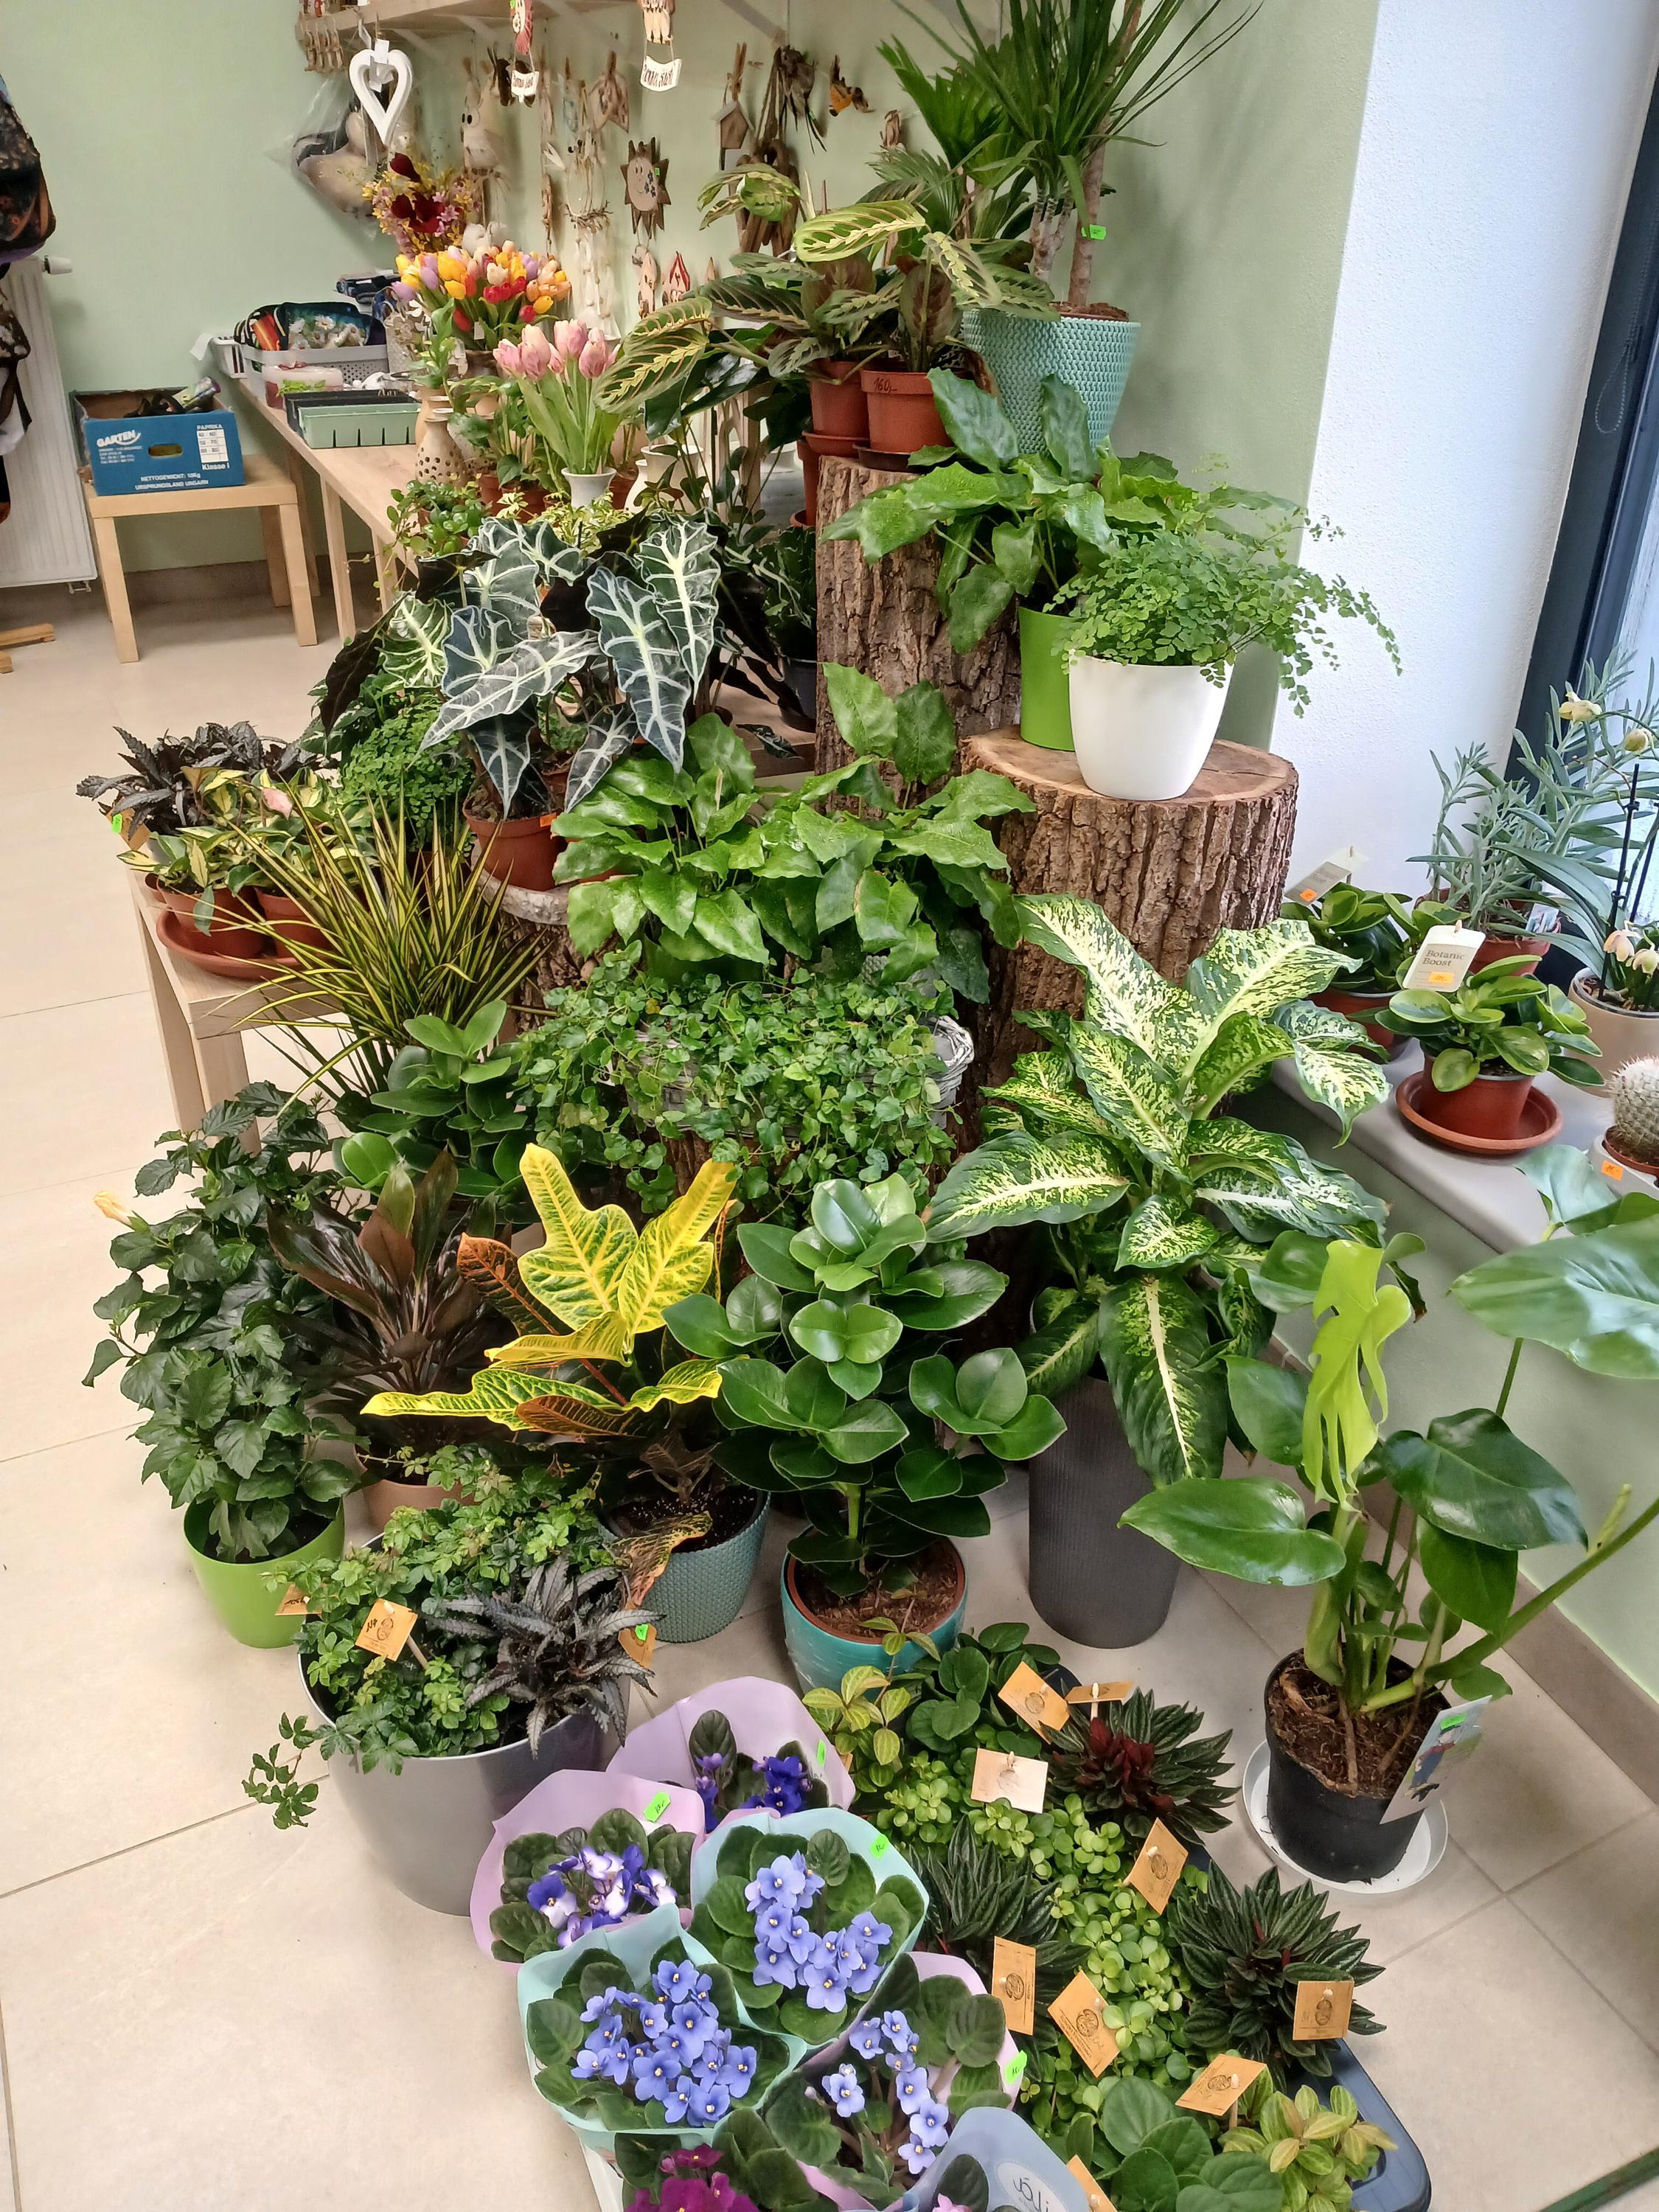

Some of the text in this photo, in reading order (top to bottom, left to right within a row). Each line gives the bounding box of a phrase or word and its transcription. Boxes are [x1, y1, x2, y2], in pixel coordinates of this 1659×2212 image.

[97, 429, 136, 447] GARTEN
[1426, 950, 1467, 960] Botanic
[1422, 958, 1452, 967] Boost
